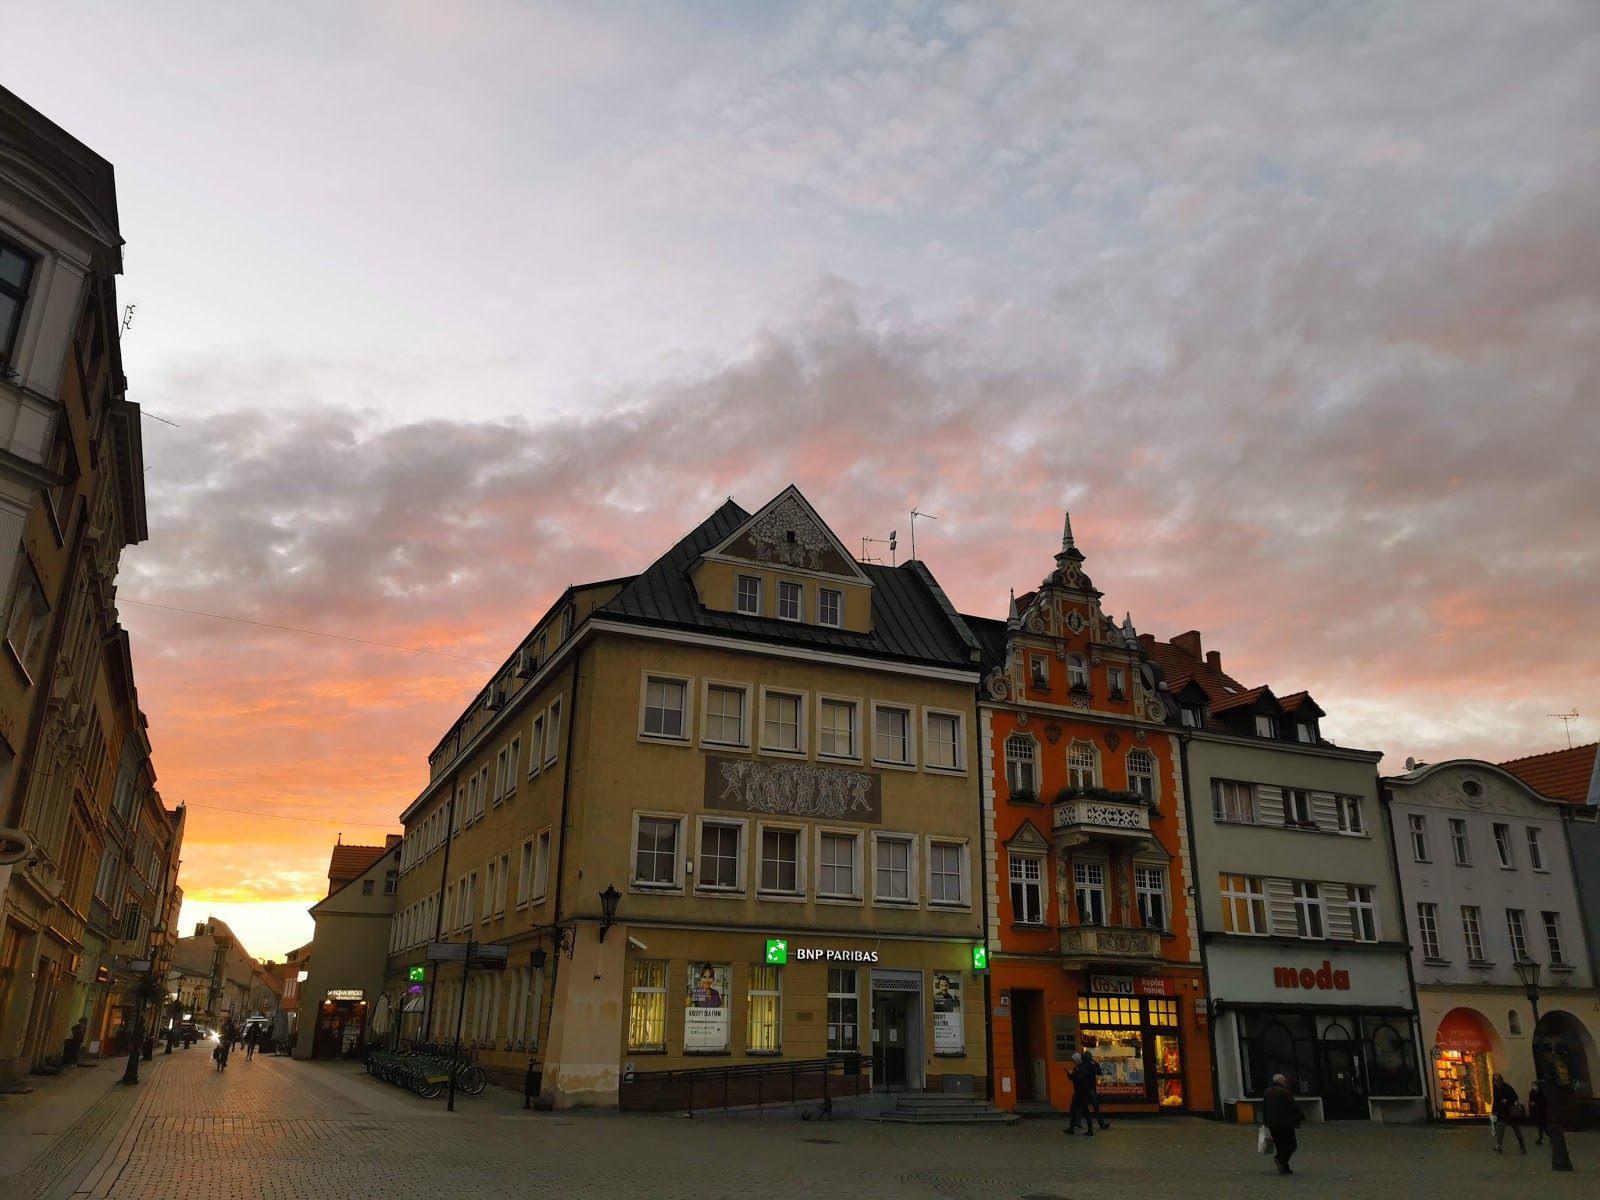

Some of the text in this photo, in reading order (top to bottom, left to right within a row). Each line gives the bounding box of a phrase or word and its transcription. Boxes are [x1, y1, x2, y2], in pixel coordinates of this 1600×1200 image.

[796, 948, 879, 963] BNP PARIBAS
[1142, 977, 1165, 987] kupisz
[1273, 960, 1351, 990] moda
